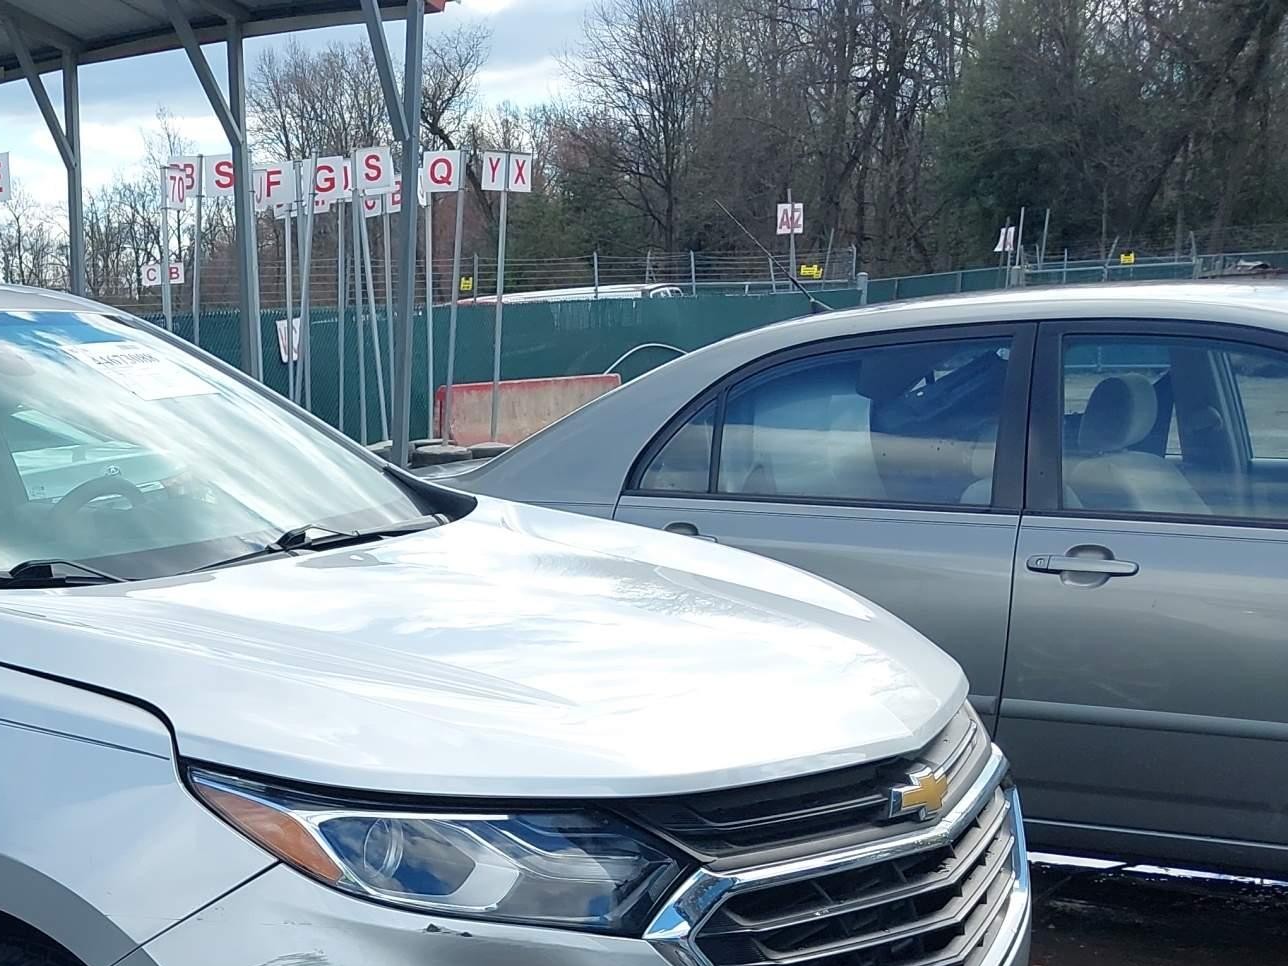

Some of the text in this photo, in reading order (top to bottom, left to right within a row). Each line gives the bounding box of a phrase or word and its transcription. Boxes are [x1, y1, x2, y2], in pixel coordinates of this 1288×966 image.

[214, 160, 235, 189] S
[314, 165, 337, 193] G
[365, 154, 382, 182] S
[429, 157, 453, 186] Q
[488, 156, 501, 183] Y
[514, 158, 527, 185] X
[169, 175, 185, 203] 70
[266, 169, 282, 198] F
[146, 267, 157, 282] C
[168, 266, 180, 280] B
